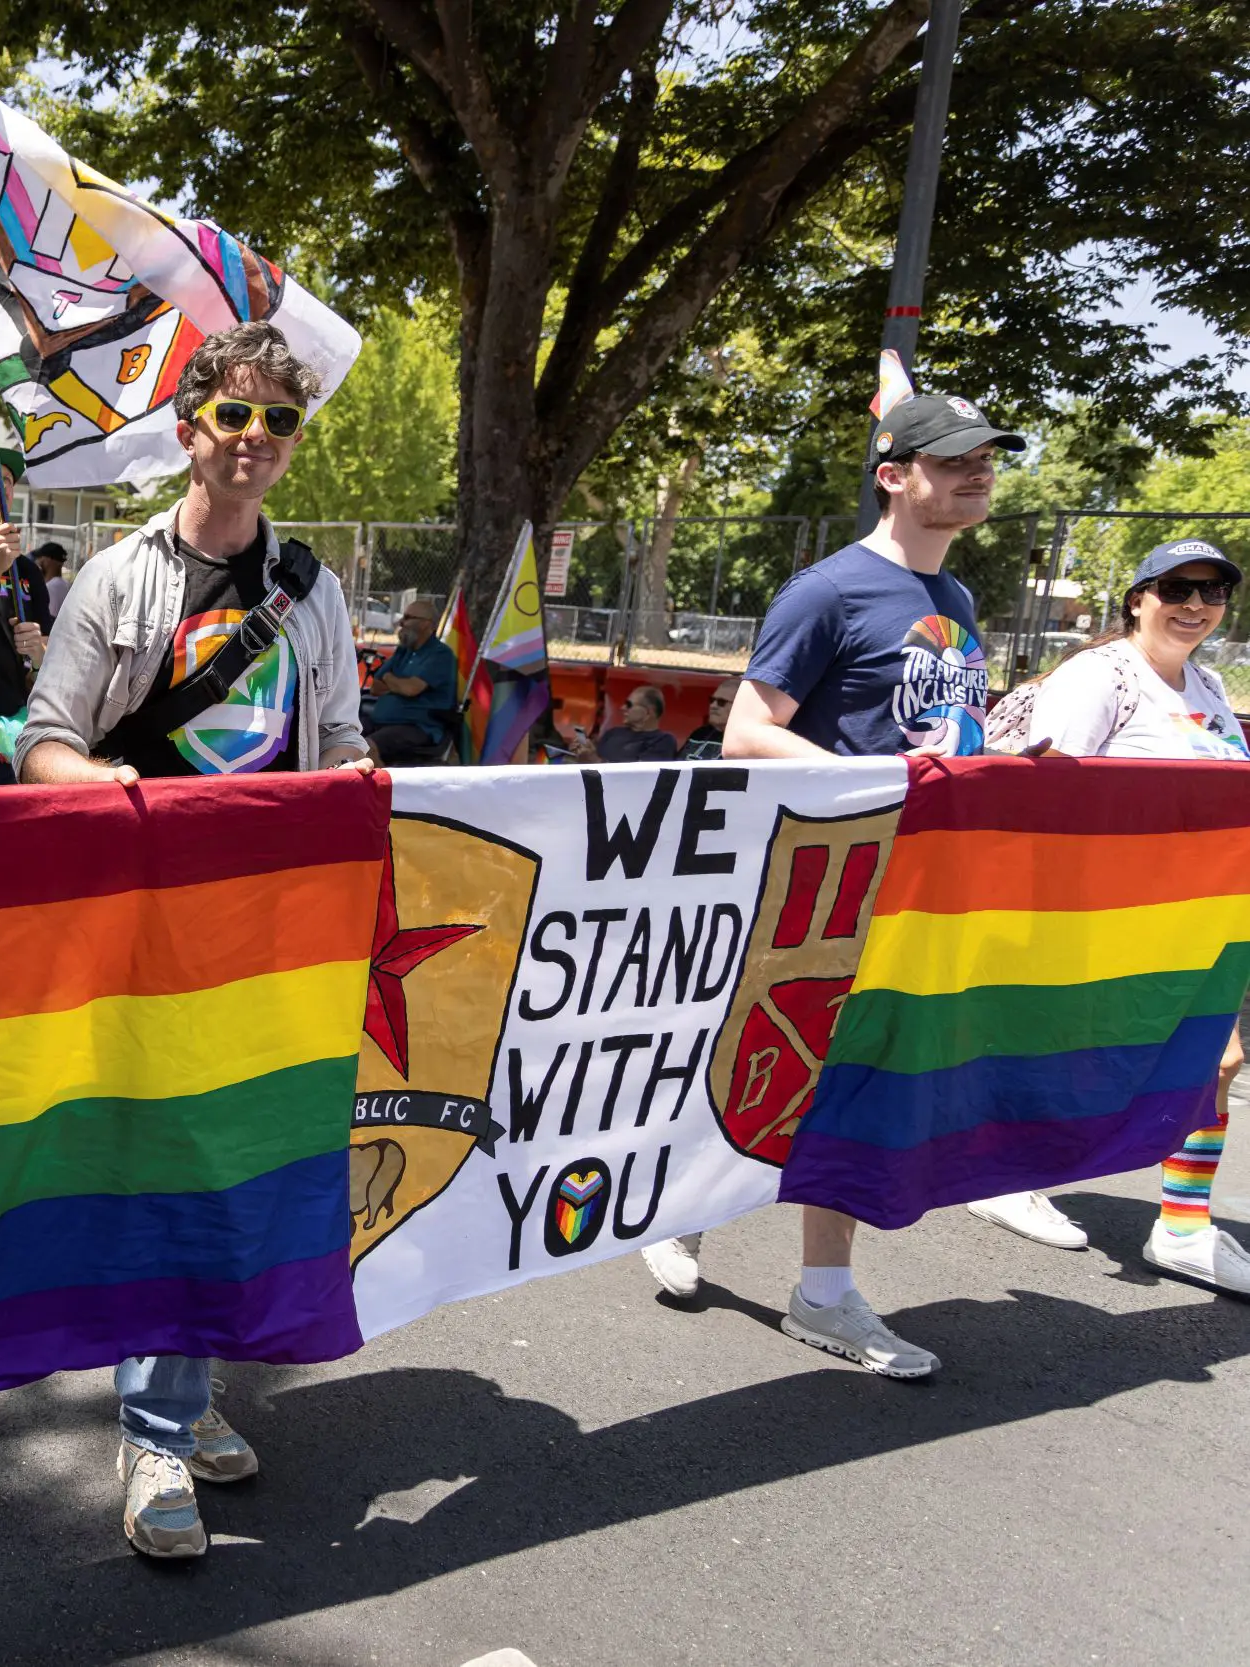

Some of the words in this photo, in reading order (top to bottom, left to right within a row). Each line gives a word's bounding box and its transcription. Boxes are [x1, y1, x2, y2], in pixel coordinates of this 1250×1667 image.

[901, 646, 937, 684] THE
[934, 658, 986, 690] FUTURE
[581, 767, 749, 882] WE
[518, 902, 743, 1021] STAND
[439, 1100, 475, 1128] FC
[508, 1028, 710, 1145] WITH
[736, 1046, 780, 1115] B
[496, 1144, 672, 1271] YOU
